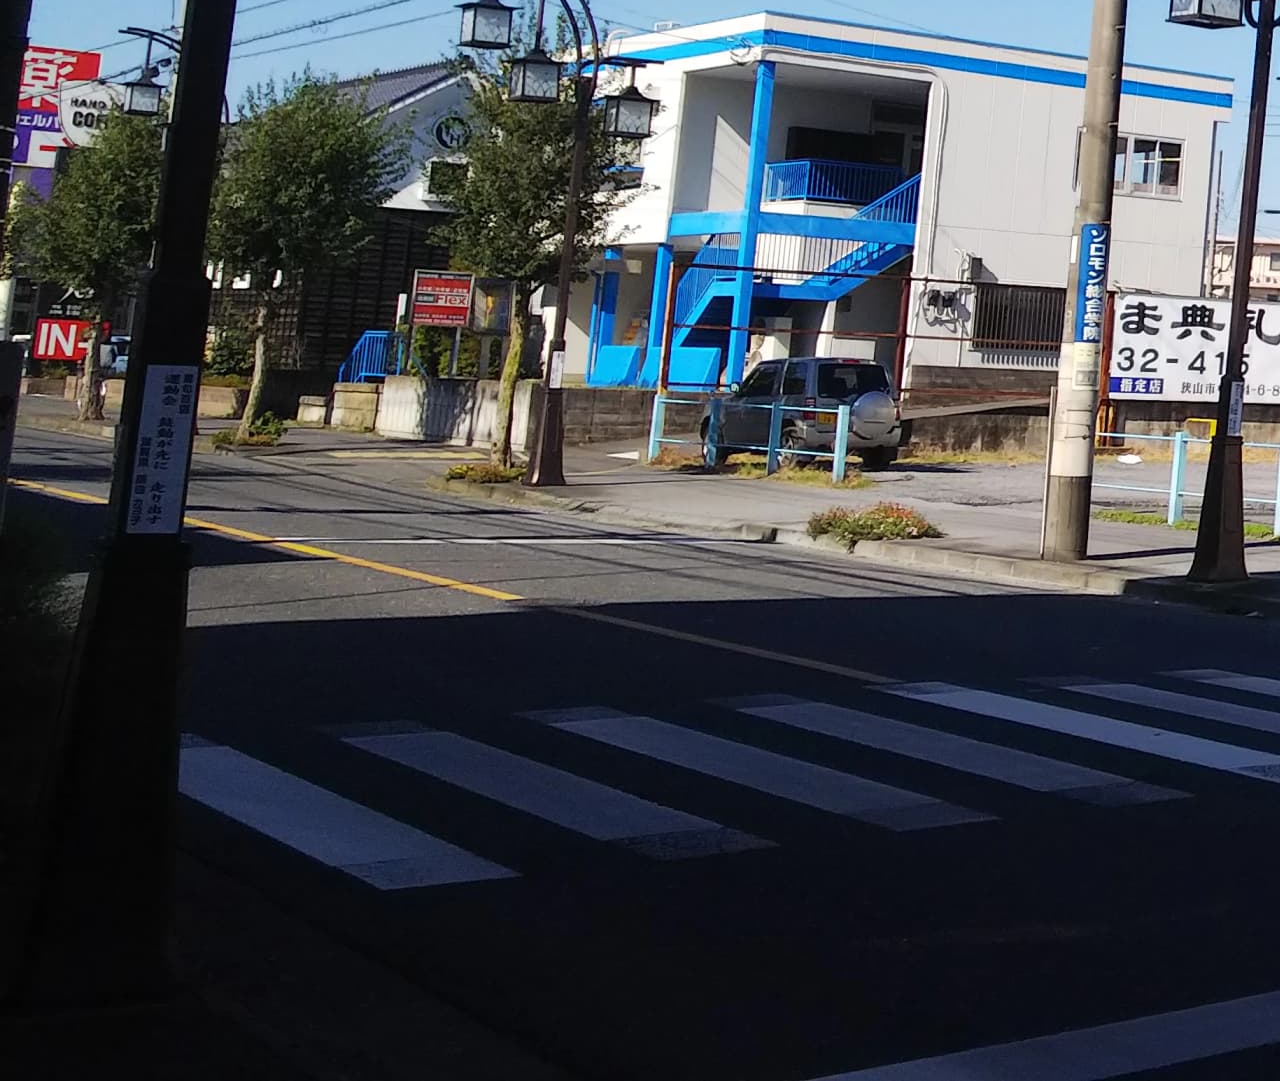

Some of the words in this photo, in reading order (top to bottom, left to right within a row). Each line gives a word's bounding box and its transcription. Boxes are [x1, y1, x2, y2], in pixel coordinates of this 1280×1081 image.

[19, 51, 77, 108] 薬
[37, 322, 77, 357] IN
[1120, 378, 1162, 394] 指定店
